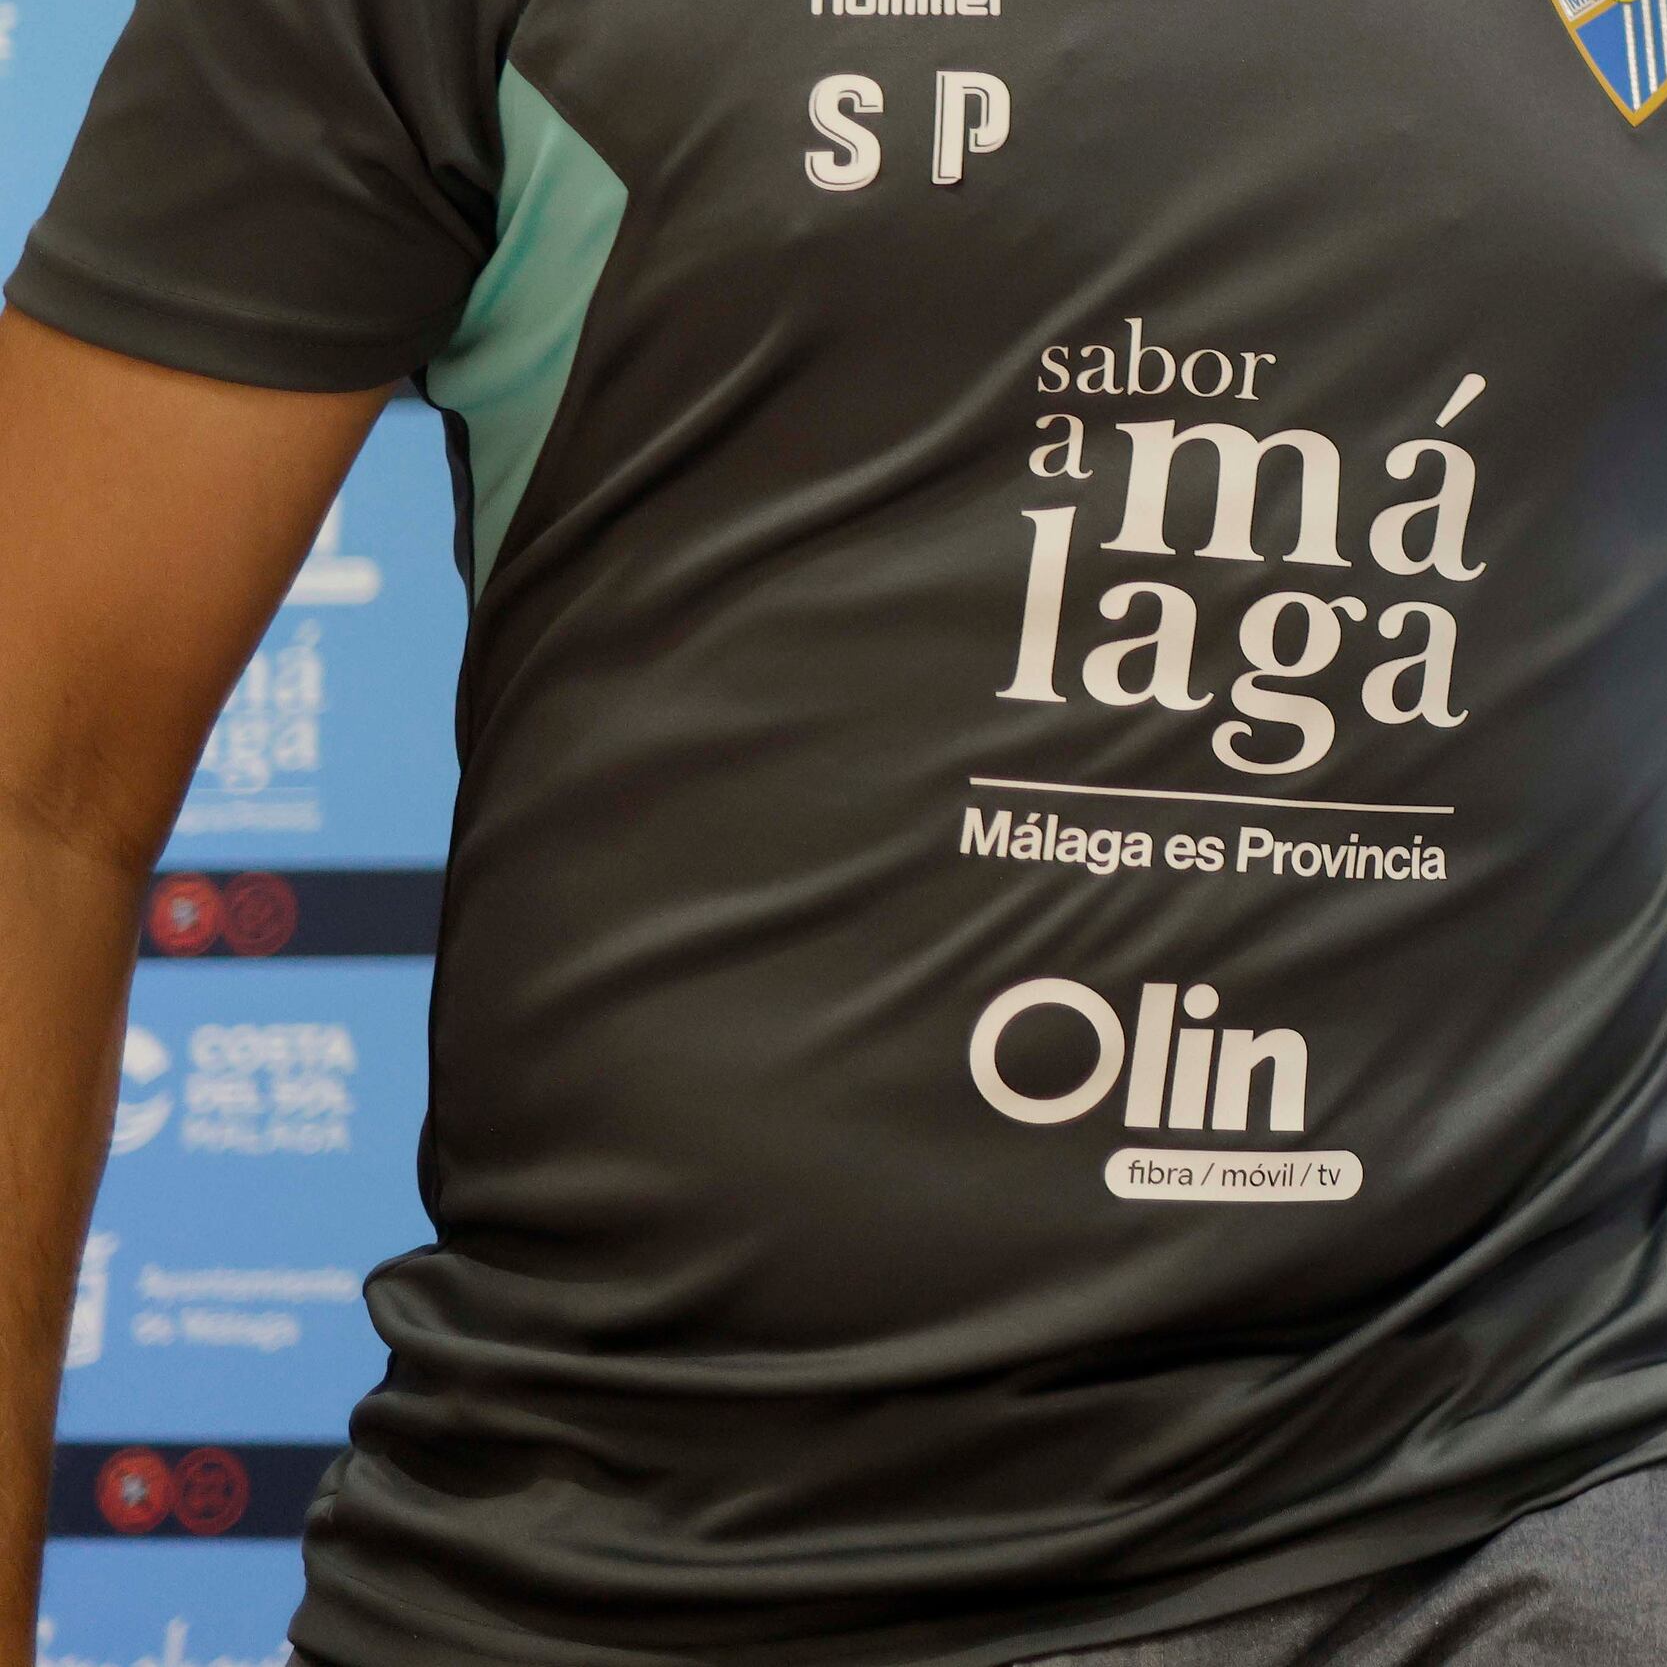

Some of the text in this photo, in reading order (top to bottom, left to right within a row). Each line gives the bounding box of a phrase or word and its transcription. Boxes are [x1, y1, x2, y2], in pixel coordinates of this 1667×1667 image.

[805, 70, 1011, 192] S P
[1037, 319, 1276, 400] sabor
[1028, 372, 1487, 583] a má
[994, 504, 1470, 775] laga
[960, 807, 1447, 881] Málaga es Provincia
[969, 977, 1309, 1134] Olin
[1128, 1160, 1193, 1186] fibra
[1221, 1163, 1295, 1187] móvil
[1318, 1163, 1342, 1186] tv
